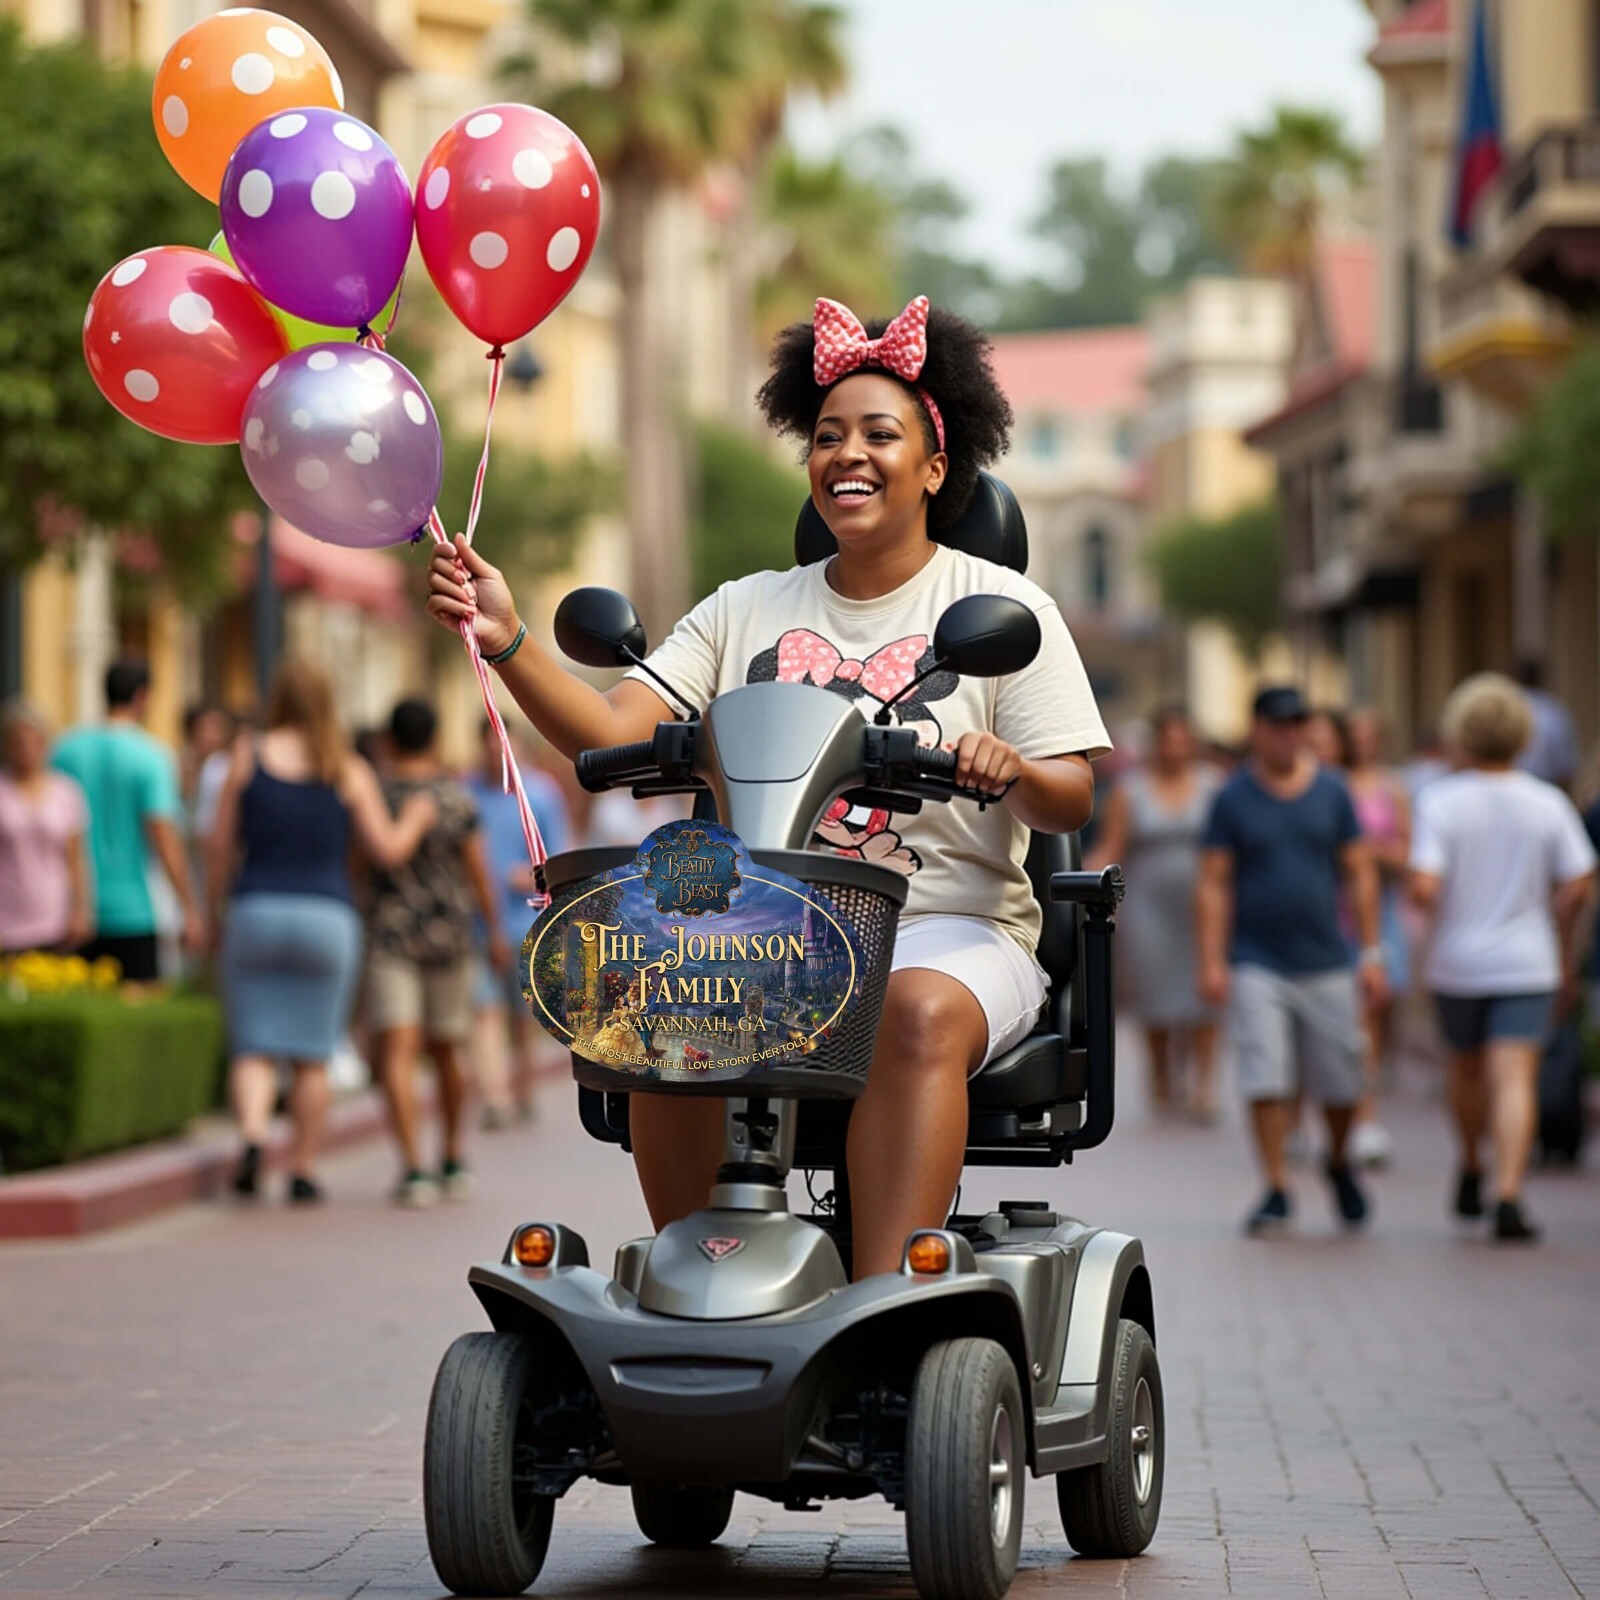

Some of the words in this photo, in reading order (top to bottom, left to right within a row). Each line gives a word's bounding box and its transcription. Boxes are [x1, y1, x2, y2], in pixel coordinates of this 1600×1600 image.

[661, 852, 715, 880] BEAUTY
[672, 878, 723, 907] BEAST
[580, 920, 647, 972] THE
[661, 925, 806, 971] JOHNSON
[634, 961, 746, 1014] FAMILY
[620, 1016, 733, 1034] SAVANNAH,
[738, 1016, 767, 1032] GA
[578, 1037, 597, 1053] THE
[598, 1046, 629, 1061] MOST
[629, 1055, 686, 1070] BEAUTIFUL
[688, 1060, 715, 1070] LOVE
[717, 1055, 750, 1068] STORY
[752, 1047, 780, 1062] EVER
[780, 1036, 808, 1053] TOLD
